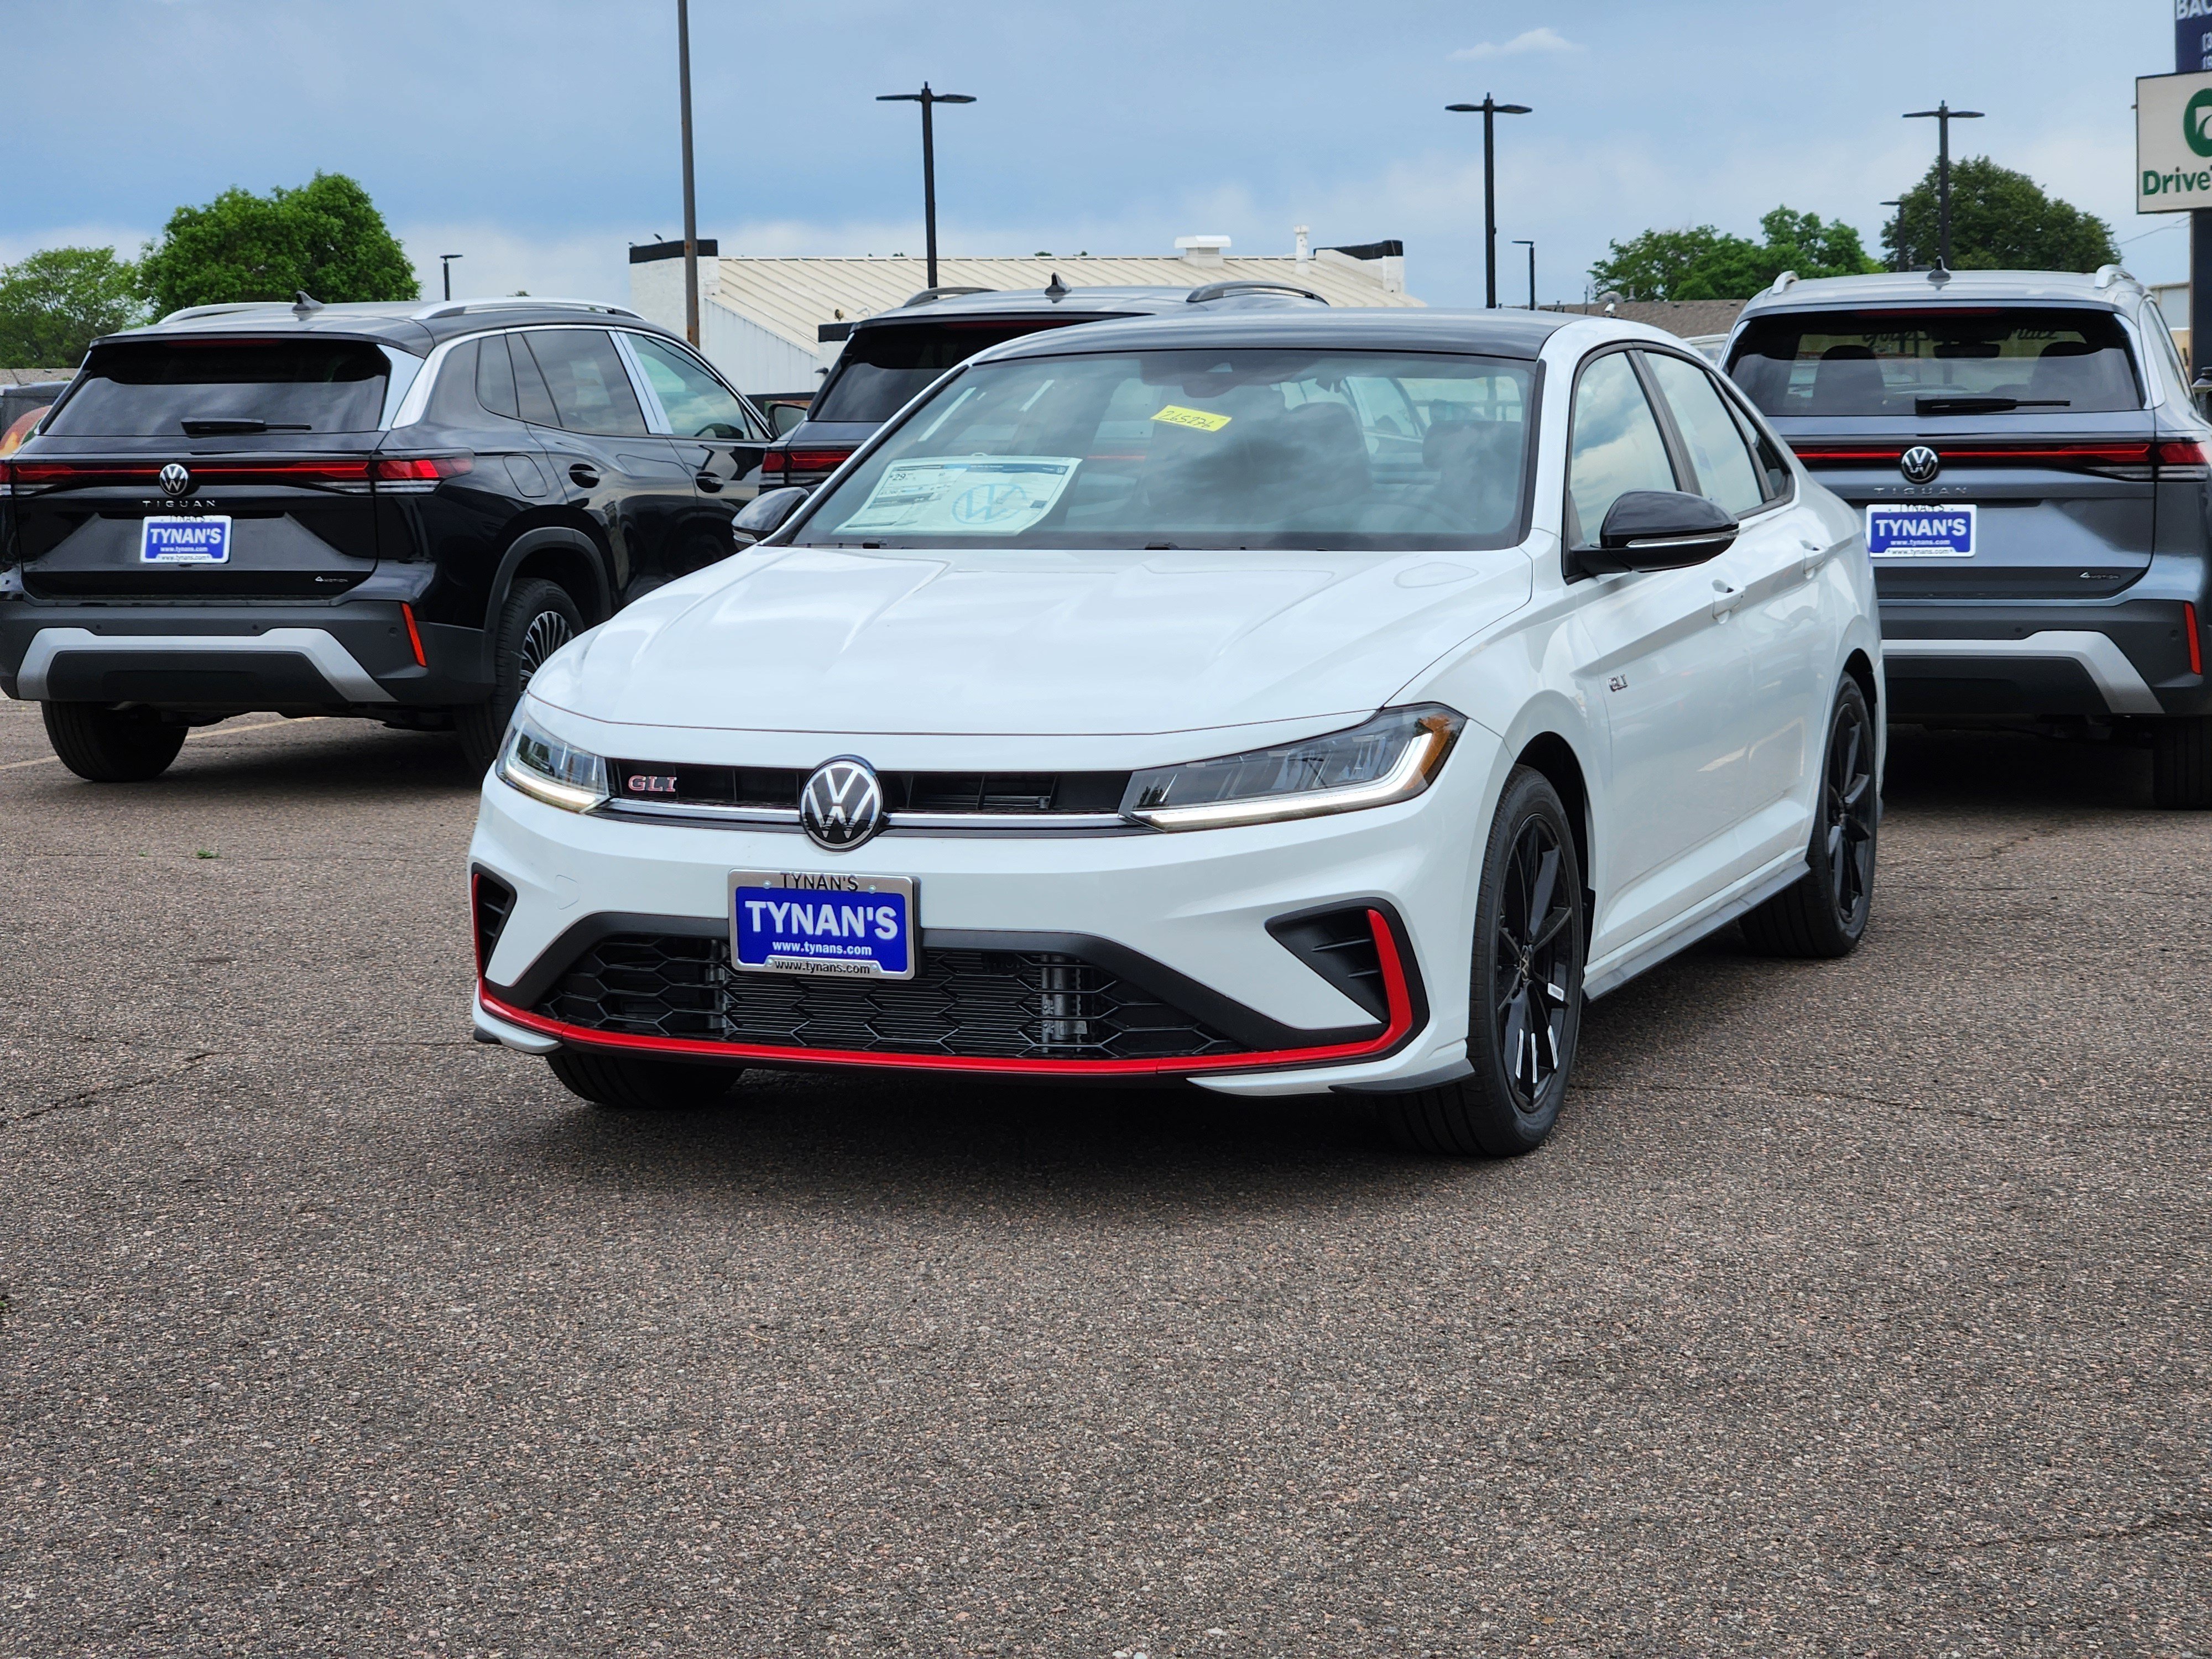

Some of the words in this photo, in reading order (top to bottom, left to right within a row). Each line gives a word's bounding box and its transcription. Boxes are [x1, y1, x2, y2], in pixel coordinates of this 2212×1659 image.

[2143, 165, 2212, 195] Drive
[1875, 518, 1966, 536] TYNAN'S
[150, 528, 221, 544] TYNAN'S
[628, 775, 677, 792] GLI
[780, 872, 859, 892] TYNAN'S
[744, 900, 899, 940] TYNAN'S
[772, 941, 873, 956] www.tynans.com
[775, 959, 871, 975] www.tynans.com
